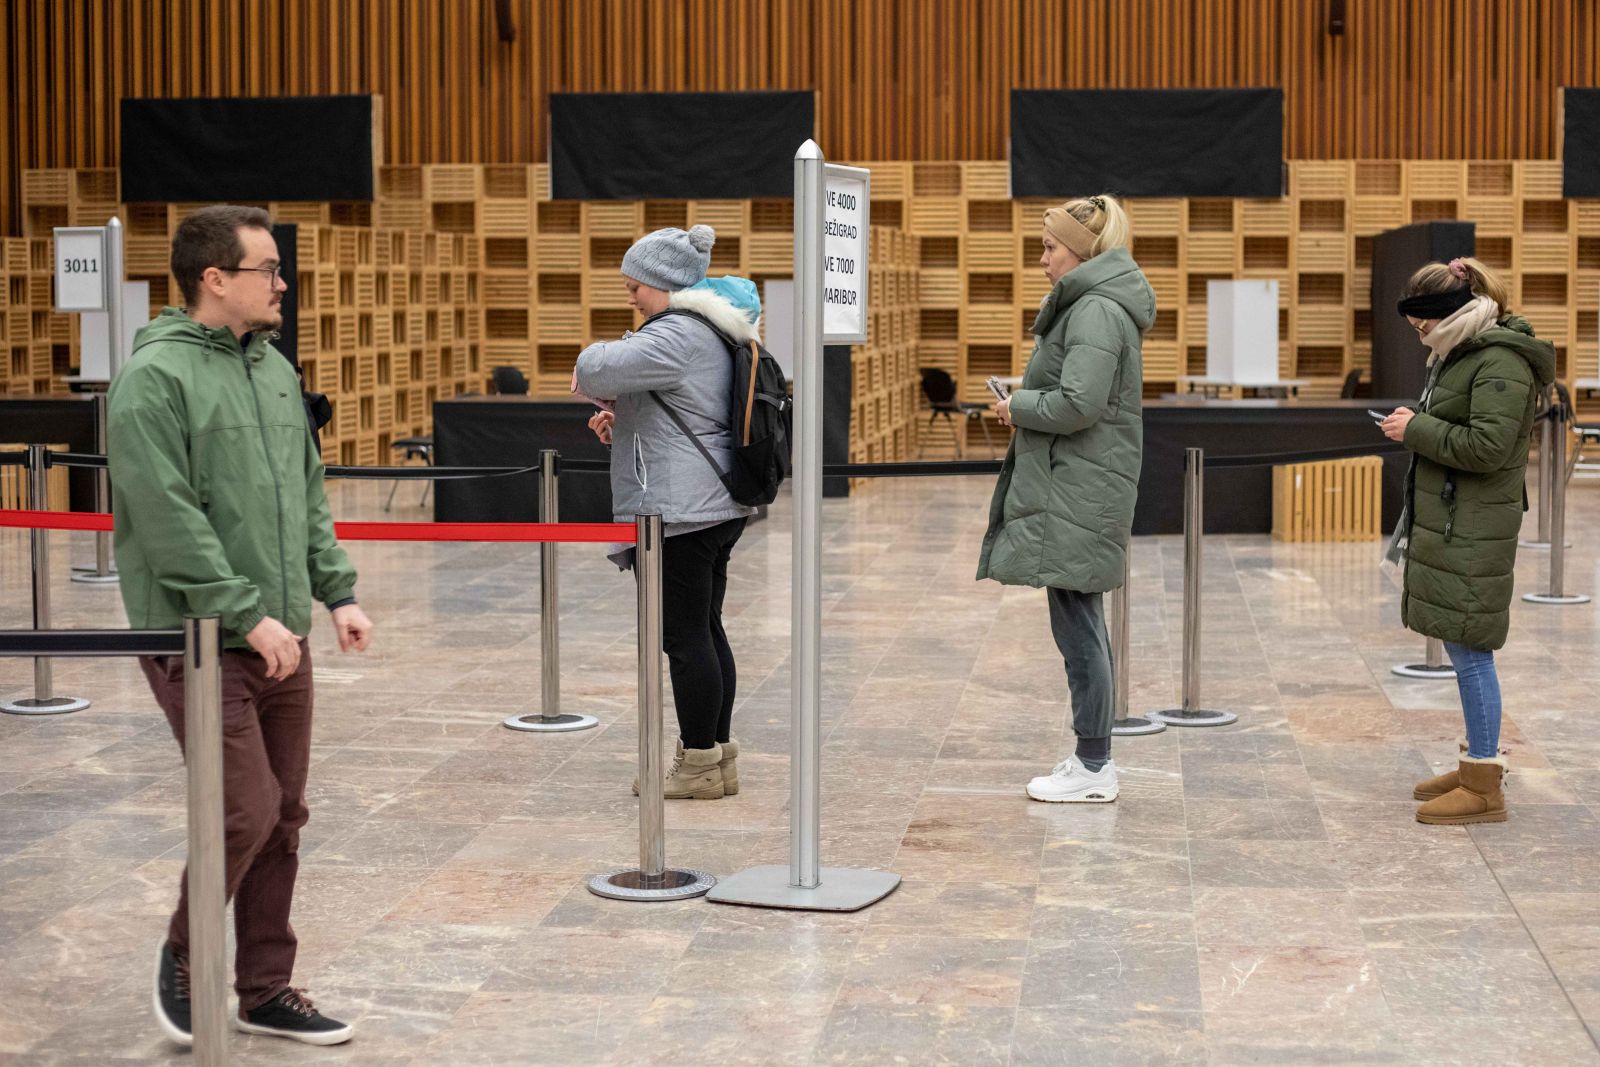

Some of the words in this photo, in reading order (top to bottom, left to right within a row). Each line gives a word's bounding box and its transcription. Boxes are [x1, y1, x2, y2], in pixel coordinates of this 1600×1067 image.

[826, 190, 836, 207] VE
[837, 192, 857, 211] 4000
[63, 258, 98, 273] 3011
[824, 255, 835, 272] VE
[836, 257, 855, 275] 7000
